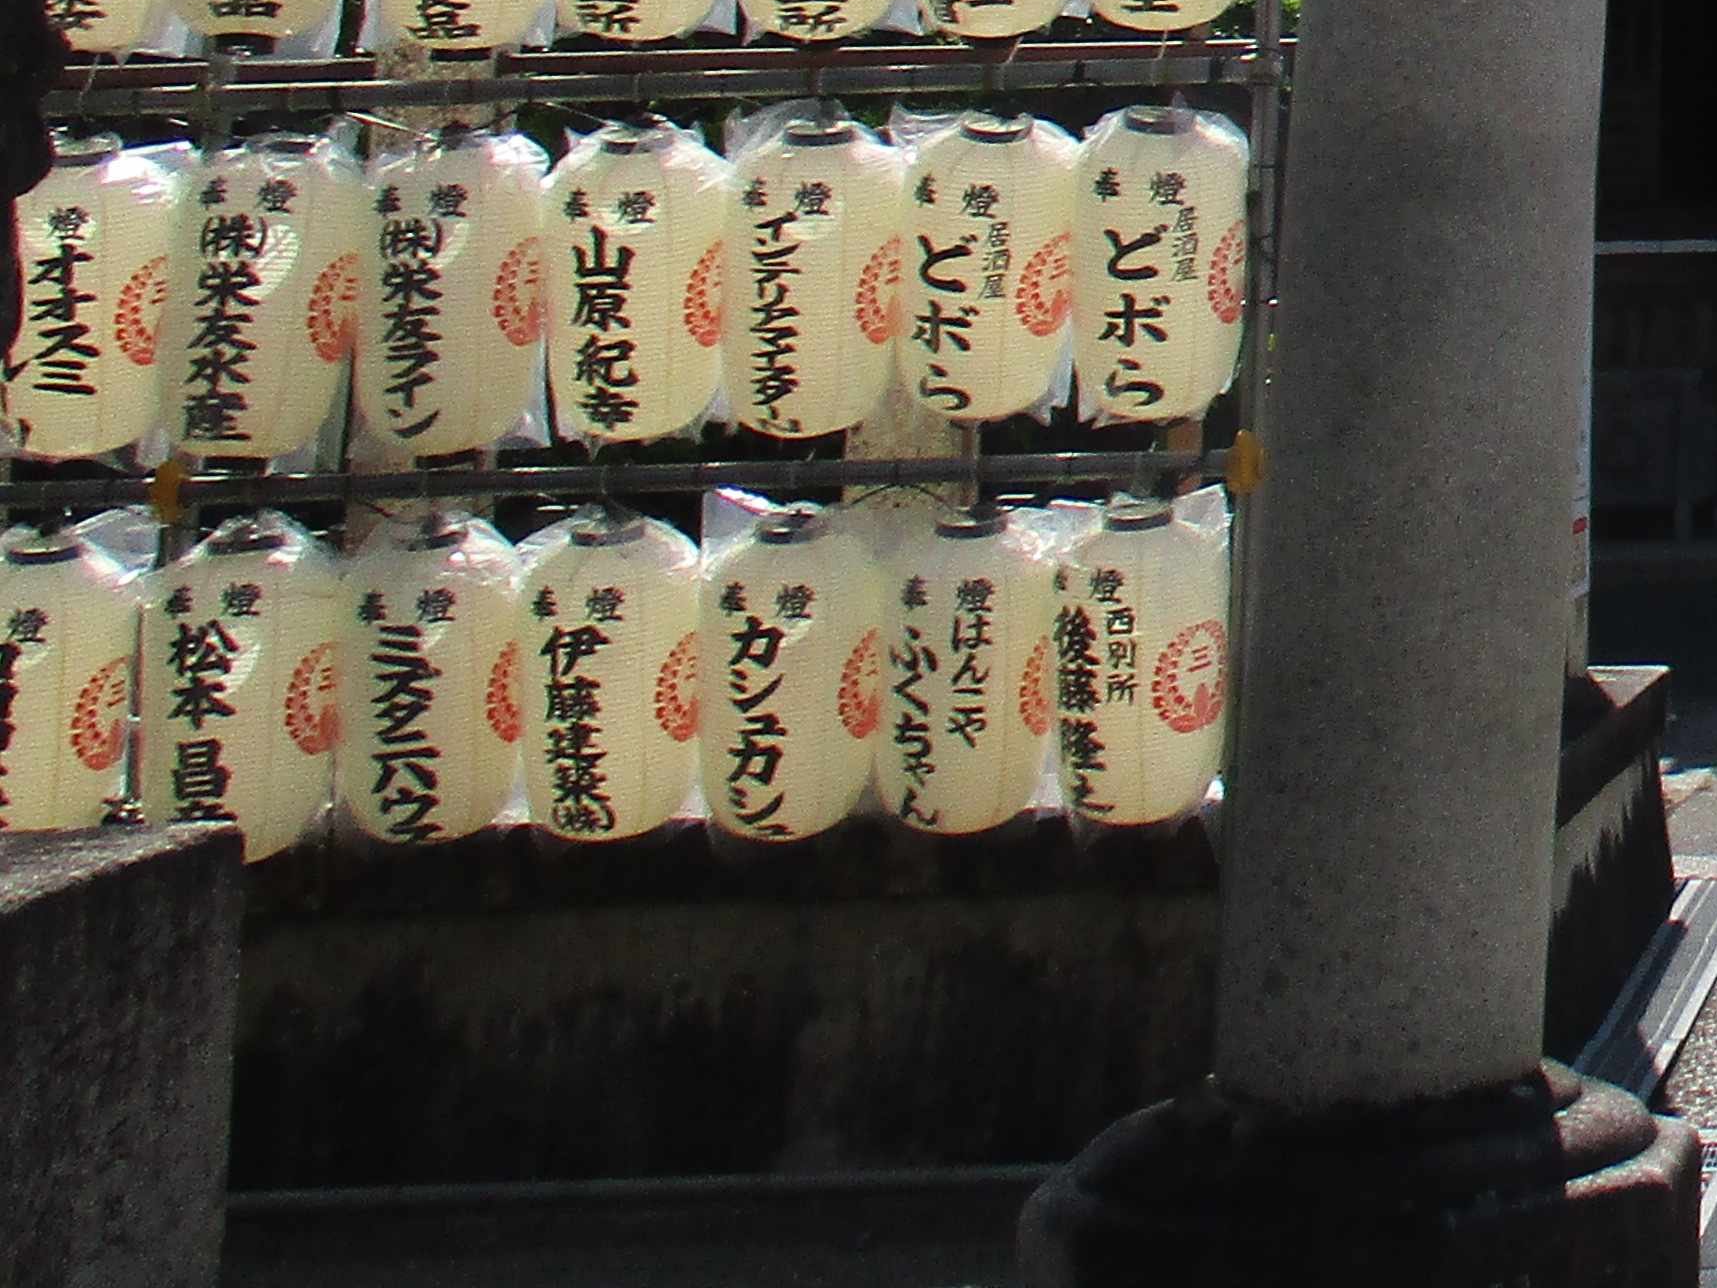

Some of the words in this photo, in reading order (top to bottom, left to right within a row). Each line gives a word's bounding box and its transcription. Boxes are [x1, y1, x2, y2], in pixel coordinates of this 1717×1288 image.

[978, 221, 1011, 300] 居酒屋
[1170, 206, 1200, 283] 居酒屋
[570, 225, 639, 431] 山原紀幸
[947, 614, 993, 749] はんこや
[1105, 606, 1142, 706] 西別所
[889, 625, 941, 826] ふくちゃん
